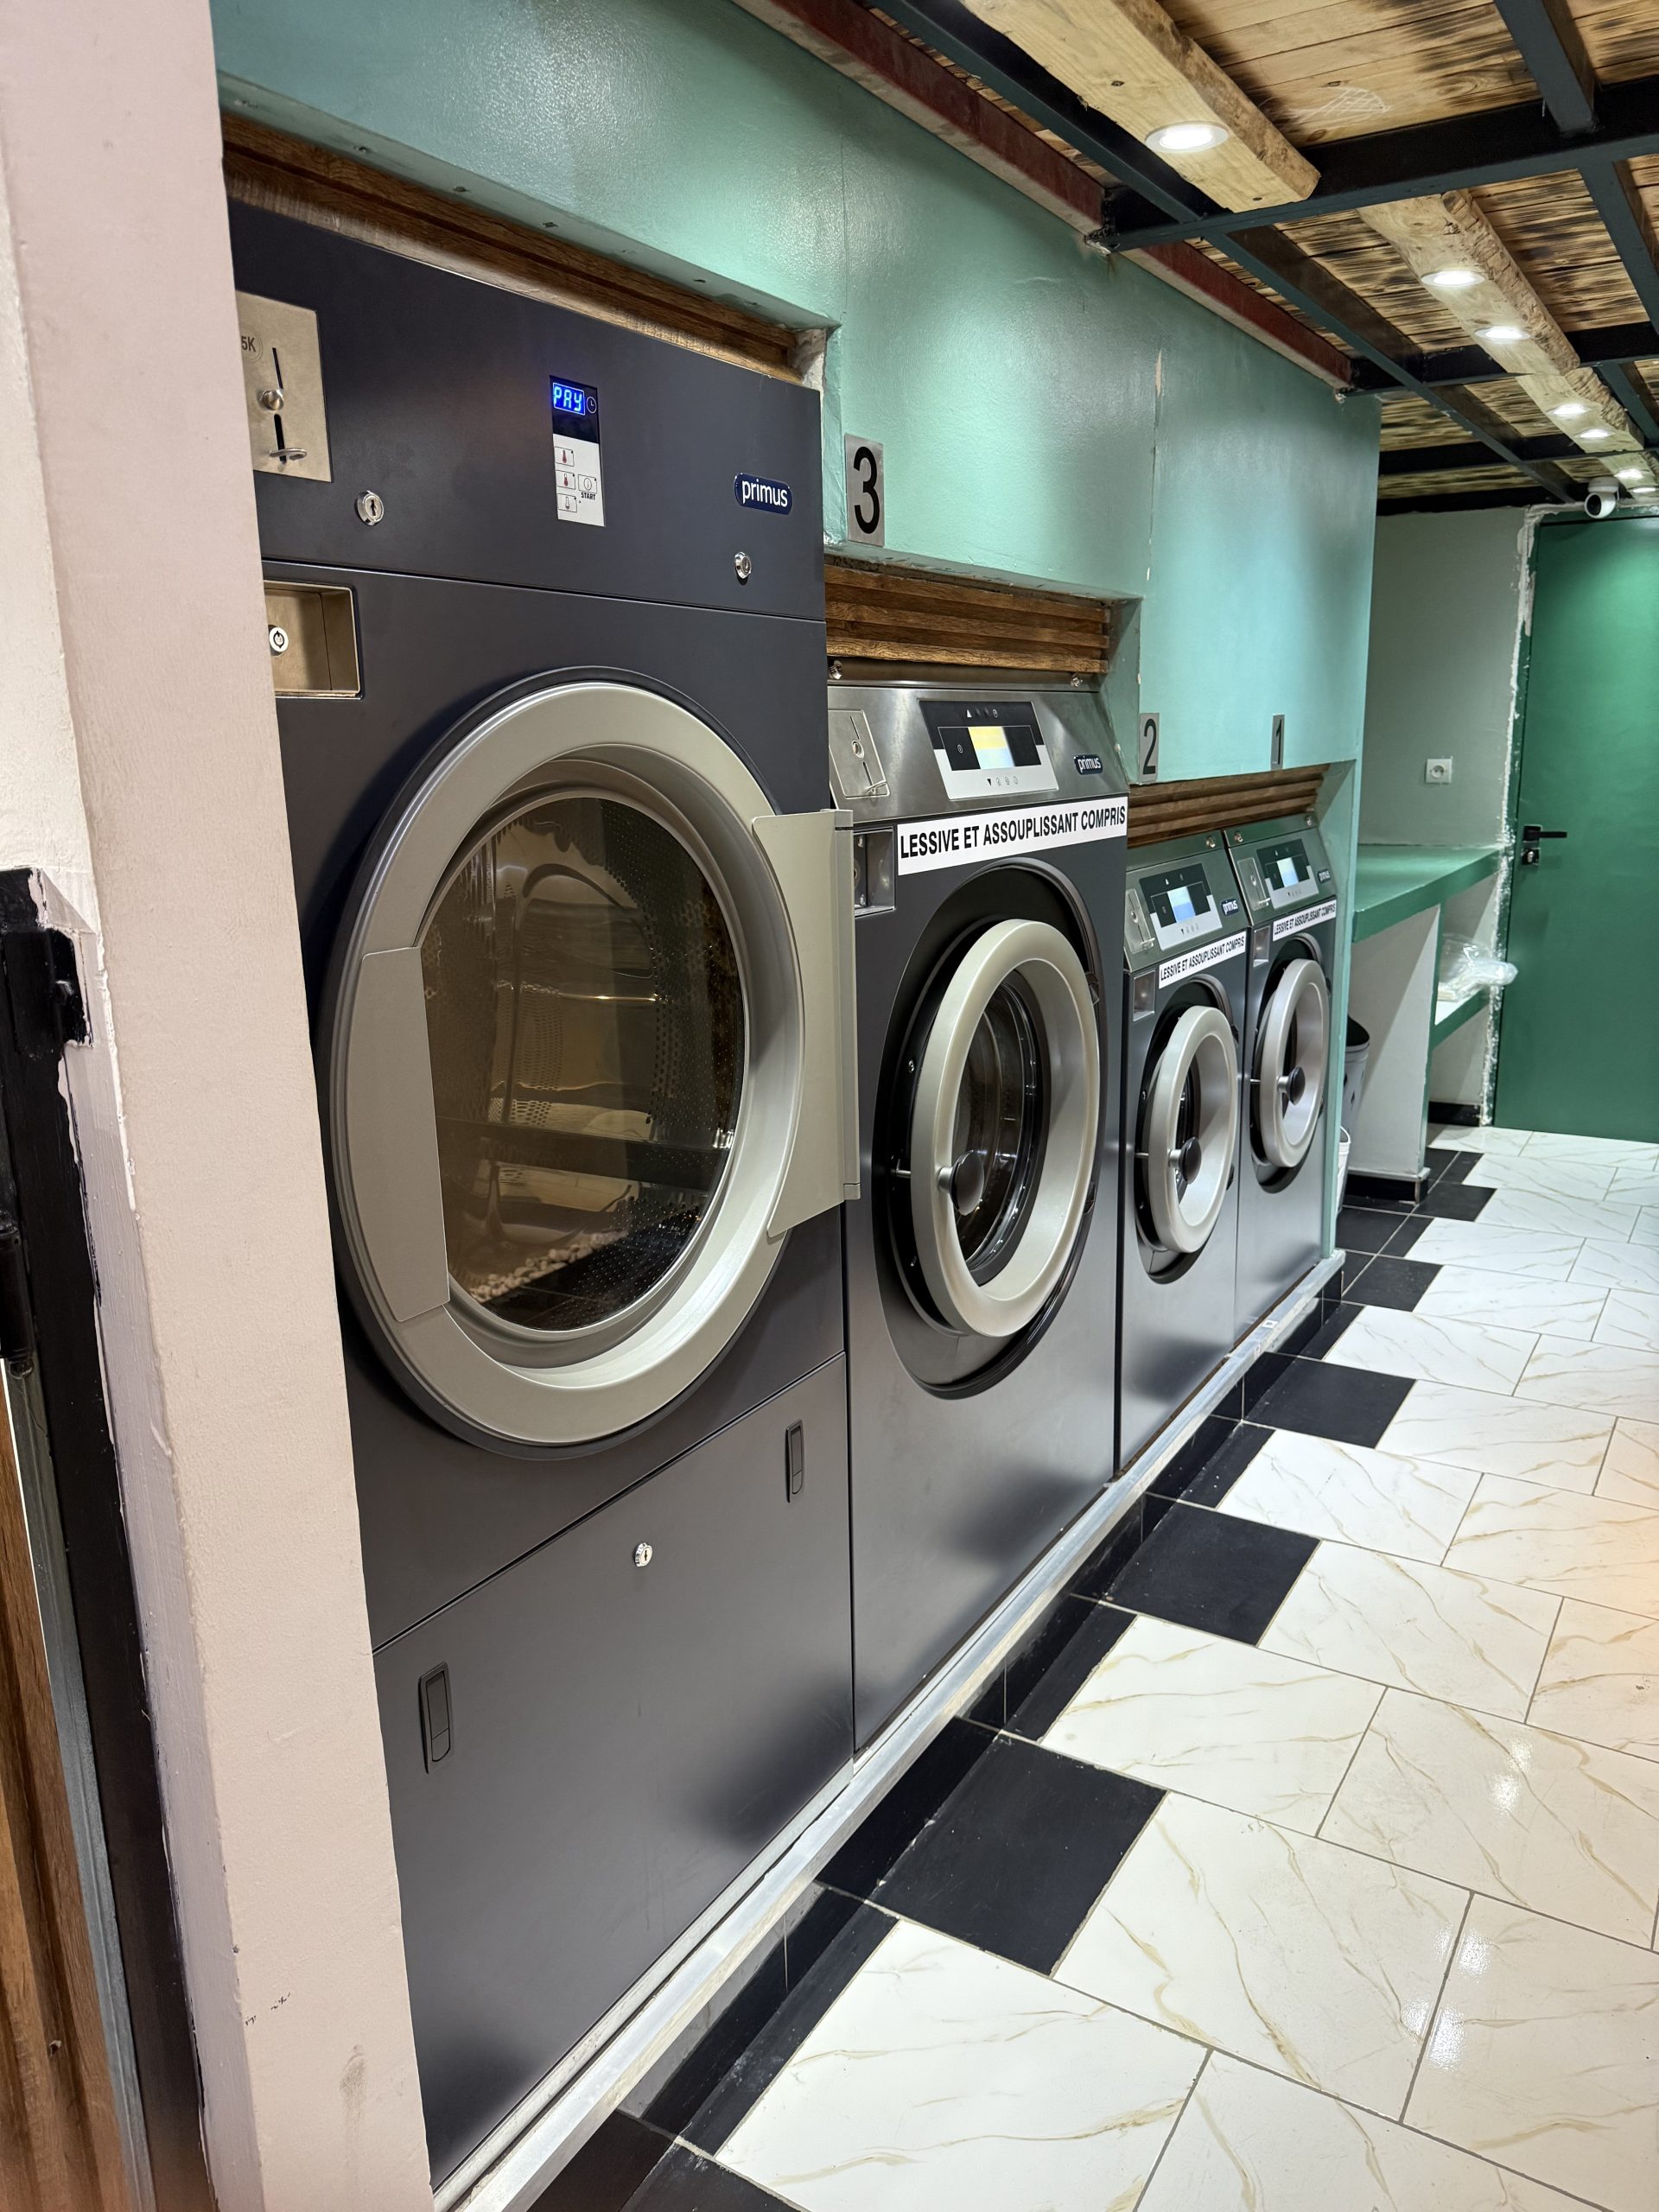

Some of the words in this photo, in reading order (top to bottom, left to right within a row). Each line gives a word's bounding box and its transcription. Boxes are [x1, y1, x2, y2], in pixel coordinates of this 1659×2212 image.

[553, 386, 582, 412] PAY
[581, 492, 596, 500] START
[741, 478, 788, 507] primus
[854, 447, 880, 534] 3
[1077, 756, 1102, 773] primus
[1143, 718, 1157, 775] 2
[1275, 719, 1282, 765] 1
[900, 829, 960, 858] LESSIVE
[963, 825, 980, 849] ET
[983, 812, 1078, 846] ASSOUPLISSANT
[1081, 805, 1126, 830] COMPRIS
[1160, 962, 1181, 982] LESSIVE
[1182, 958, 1188, 971] ET
[1188, 944, 1225, 970] ASSOUPLISSANT
[1226, 936, 1245, 953] COMPRIS
